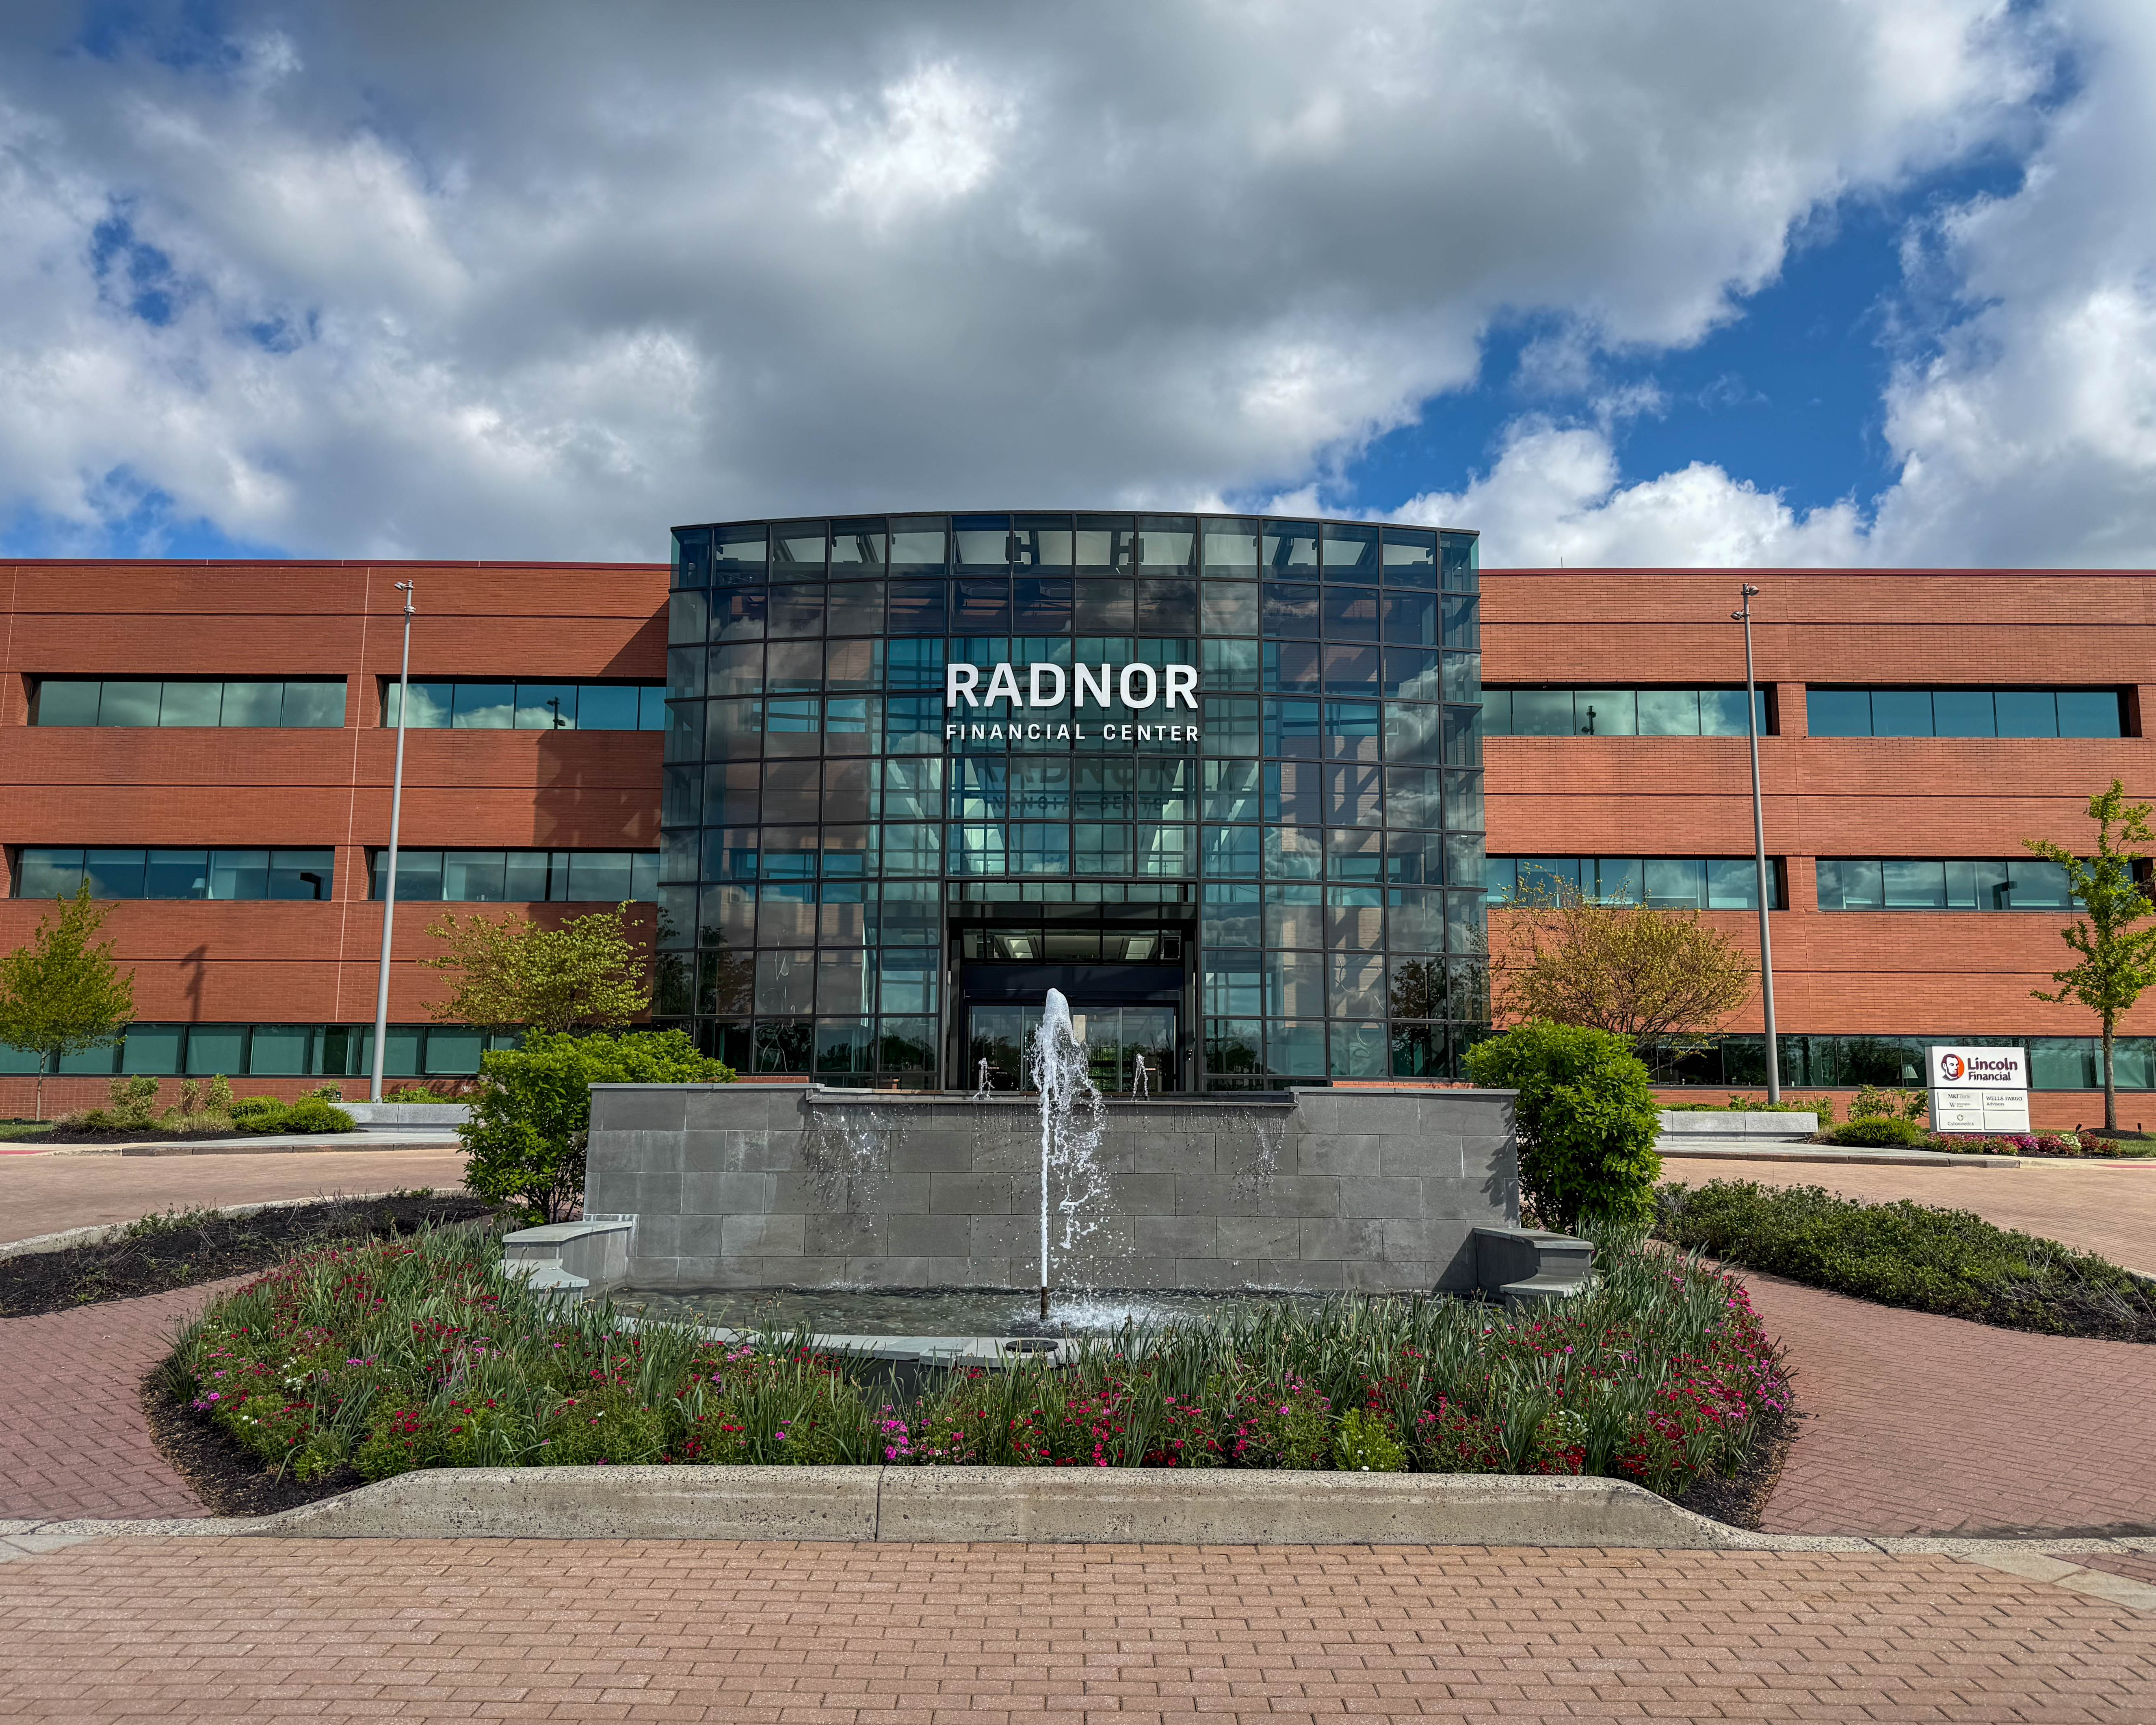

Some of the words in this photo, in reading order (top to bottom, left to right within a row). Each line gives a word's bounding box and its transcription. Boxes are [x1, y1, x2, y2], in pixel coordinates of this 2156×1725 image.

[946, 663, 1198, 709] RADNOR
[946, 724, 1085, 740] FINANCIAL
[1104, 724, 1198, 741] CENTER
[1967, 1057, 2017, 1071] Lincoln
[1968, 1071, 2011, 1081] Financial
